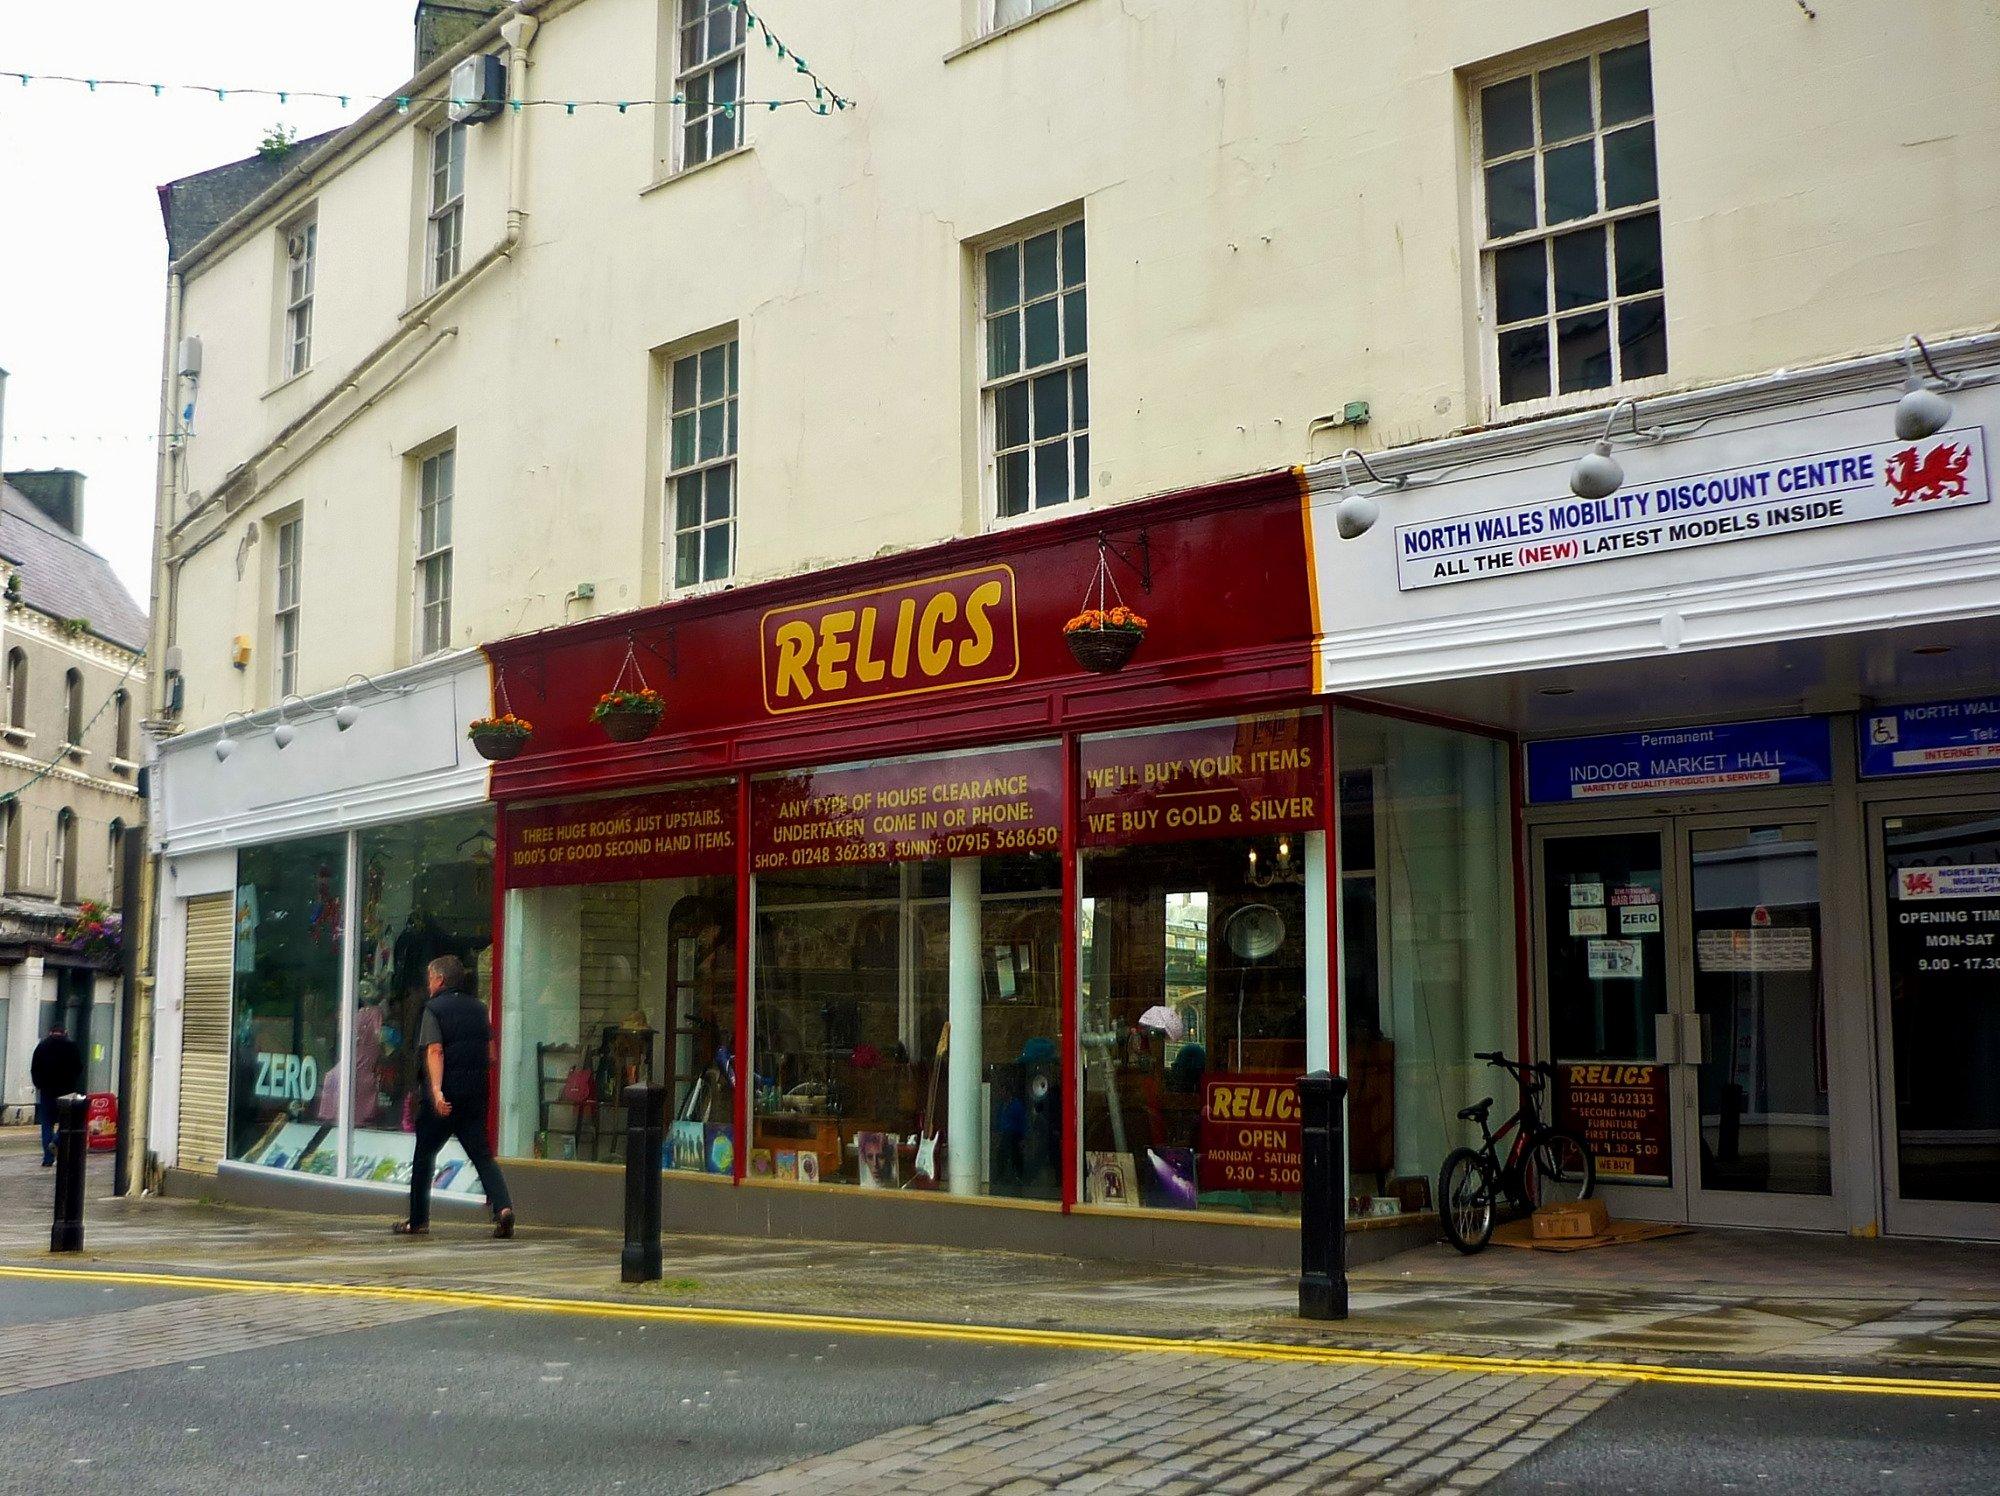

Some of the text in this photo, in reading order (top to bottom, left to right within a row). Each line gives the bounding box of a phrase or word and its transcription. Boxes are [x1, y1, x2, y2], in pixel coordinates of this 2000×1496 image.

[1404, 454, 1874, 554] NORTH WALES MOBILITY DISCOUNT CENTRE
[1433, 499, 1844, 578] ALL THE (NEW) LATEST MODELS INSIDE
[776, 580, 1002, 700] RELICS
[1903, 702, 2000, 720] NORTH WAL
[1641, 730, 1714, 746] Permanent
[1924, 747, 1980, 760] INTERNET
[1087, 747, 1311, 789] WE'LL BUY YOUR ITEMS
[1569, 750, 1786, 782] INDOOR MARKET HALL
[1582, 771, 1771, 793] VARIETY OF QUALITY PRODUCTS & SERVICES
[779, 775, 1027, 819] ANY TYPE OF HOUSE CLEARANCE
[773, 801, 1034, 843] UNDERTAKEN COME IN OR PHONE:
[1088, 797, 1315, 833] WE BUY GOLD & SILVER
[522, 809, 724, 843] THREE HUGE ROOMS JUST UPSTAIRS.
[514, 831, 734, 866] 1000'S OF GOOD SECOND HAND ITEMS.
[755, 826, 1058, 868] SHOP: 01248 362333 SUNNY: 07915 568650
[1622, 913, 1657, 924] ZERO
[1899, 910, 1968, 924] OPENING
[1925, 933, 1995, 947] MON-SAT
[1918, 958, 1950, 971] 9.00
[255, 1052, 317, 1101] ZERO
[1570, 1066, 1653, 1084] RELICS
[1572, 1092, 1653, 1105] 01248 362333
[1580, 1107, 1646, 1118] SECOND HAND
[1588, 1119, 1638, 1129] FURNITURE
[1238, 1129, 1287, 1148] OPEN
[1585, 1130, 1641, 1140] FIRST FLOOR
[1208, 1149, 1253, 1161] MONDAY
[1225, 1165, 1255, 1180] 9.30
[1270, 1168, 1301, 1183] 5.00
[1599, 1160, 1631, 1170] WE BUY
